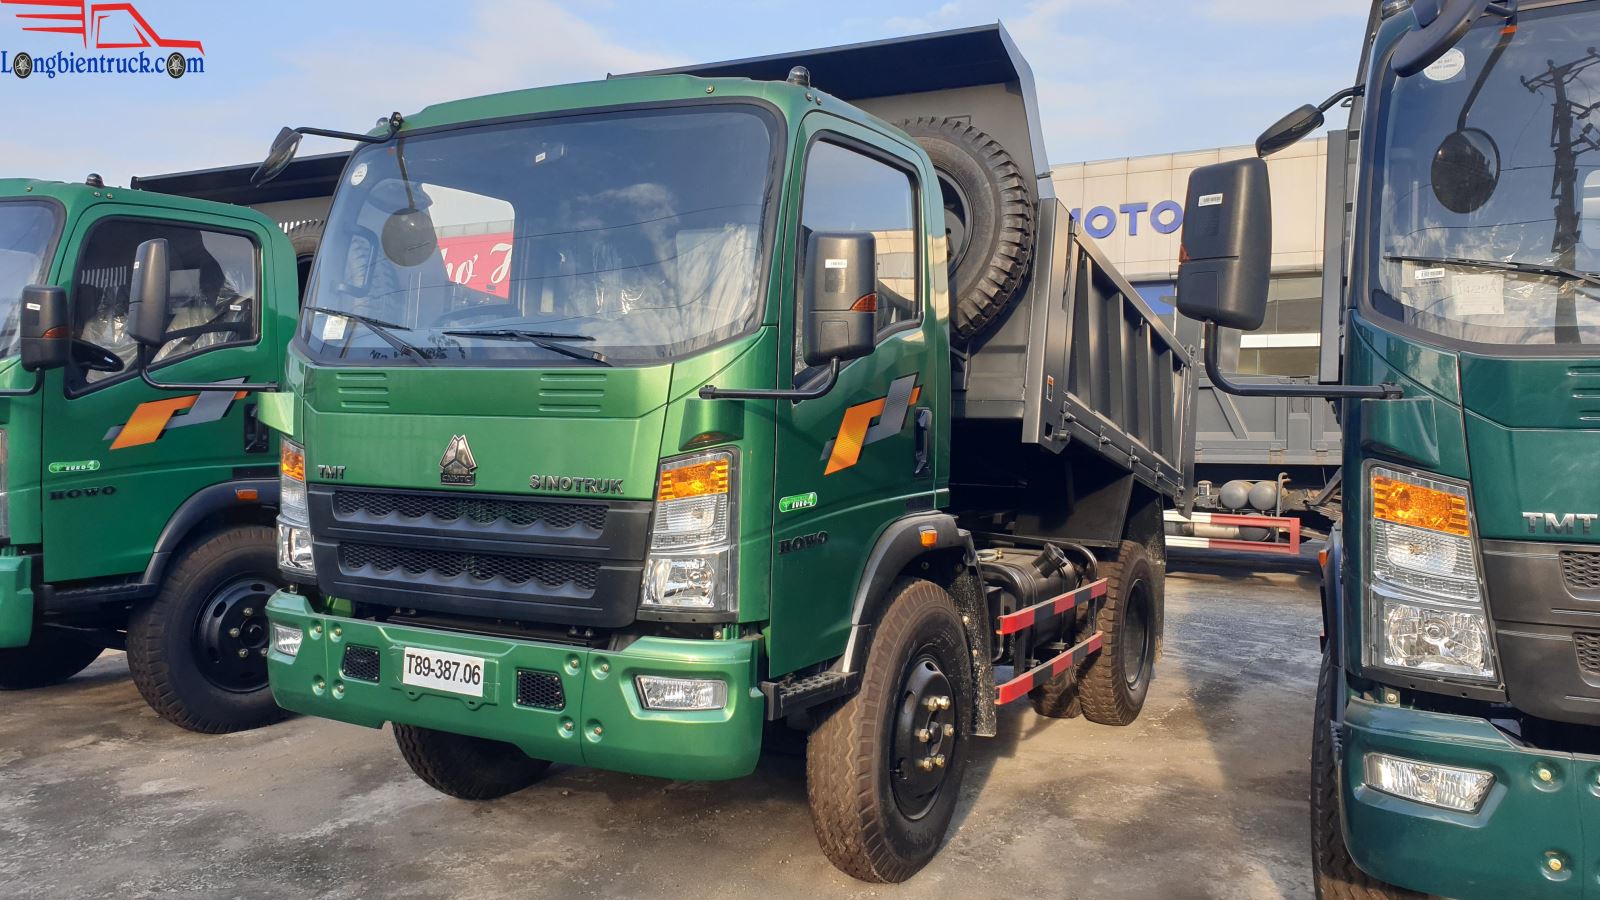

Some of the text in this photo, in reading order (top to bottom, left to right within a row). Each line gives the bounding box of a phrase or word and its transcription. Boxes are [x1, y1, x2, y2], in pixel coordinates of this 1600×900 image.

[1070, 199, 1184, 240] OTO
[317, 464, 346, 480] TMT
[529, 474, 624, 495] SINOTRUK
[48, 485, 117, 501] HOWO
[1522, 511, 1598, 536] TMT
[778, 530, 829, 555] HOWO
[405, 653, 481, 686] T89-387.06
